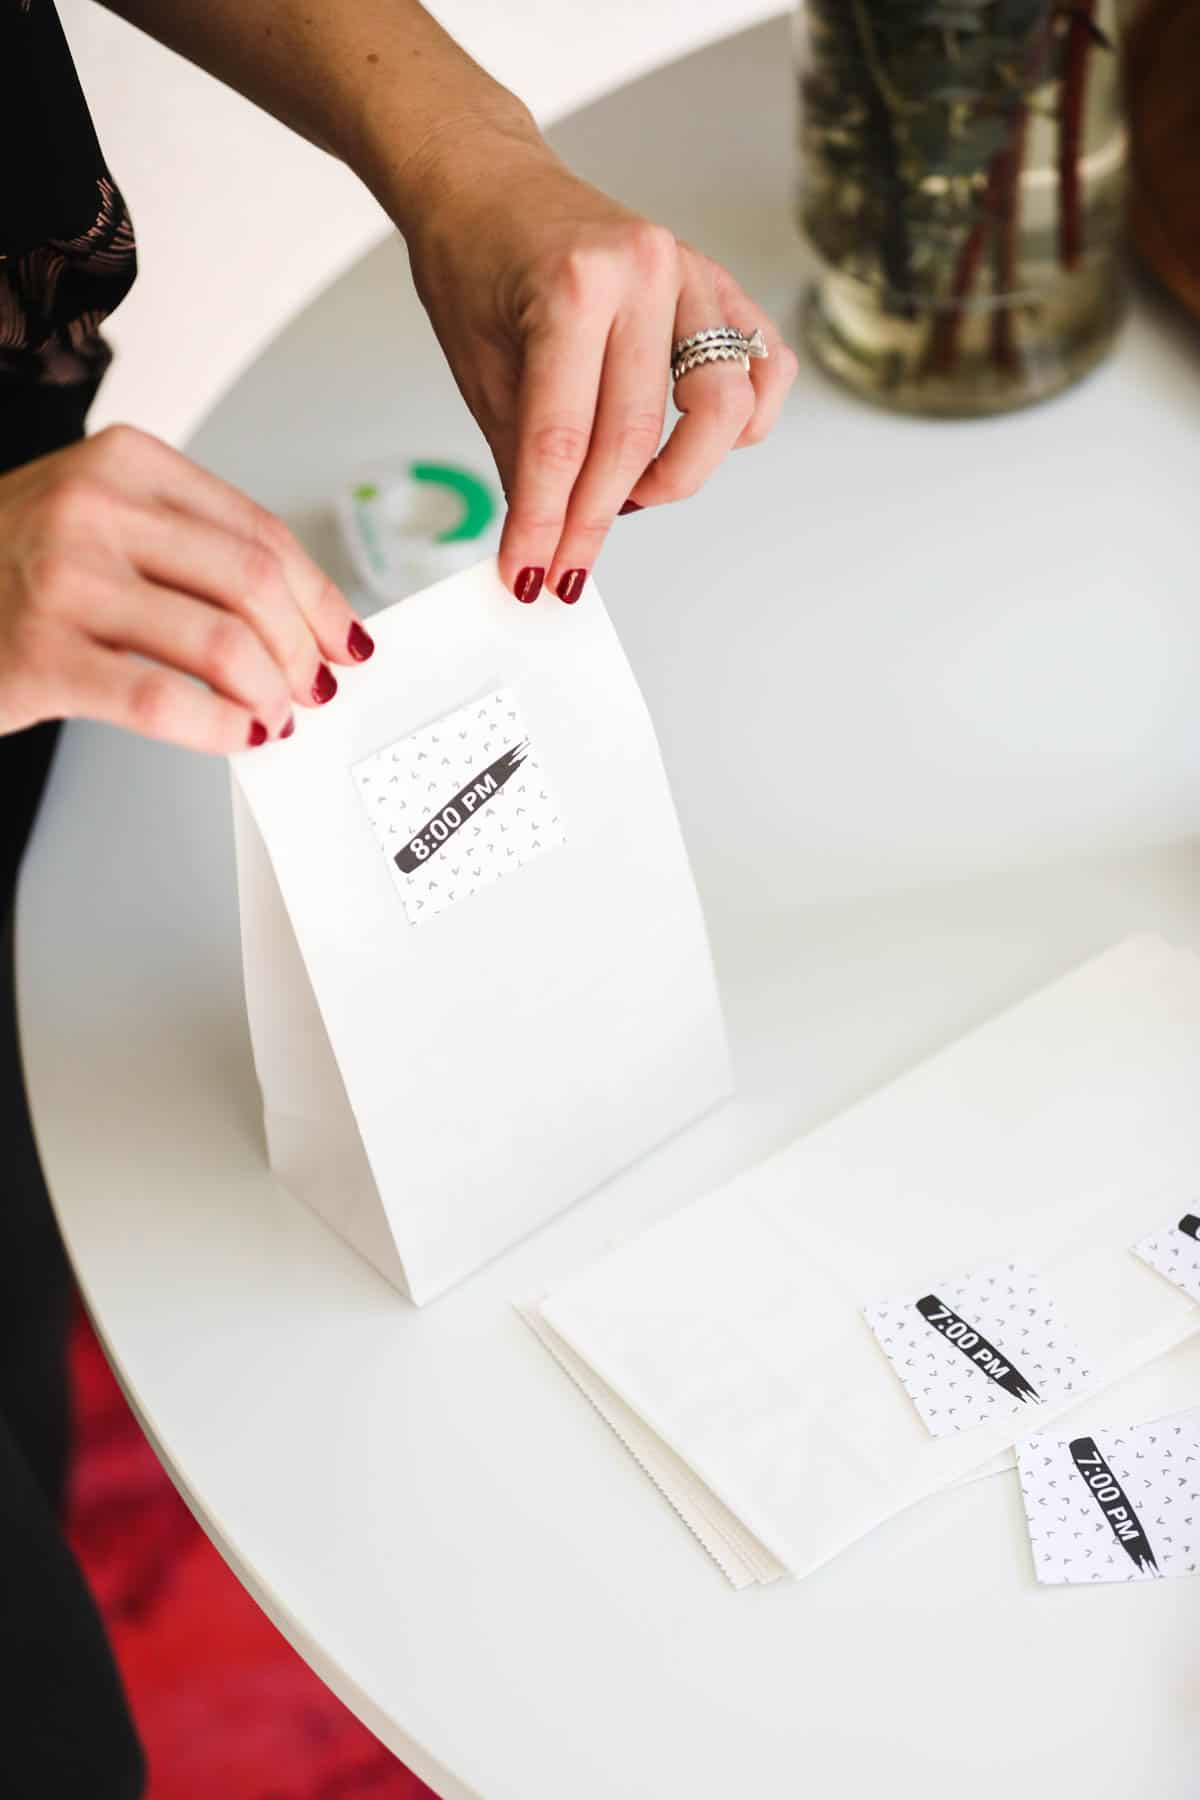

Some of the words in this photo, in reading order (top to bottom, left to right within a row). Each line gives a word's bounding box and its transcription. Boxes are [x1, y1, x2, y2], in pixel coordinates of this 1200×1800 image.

[410, 806, 461, 860] 8:00
[461, 773, 498, 812] PM
[927, 1304, 979, 1350] 7:00
[972, 1348, 1010, 1379] PM
[1076, 1451, 1121, 1502] 7:00
[1107, 1506, 1140, 1541] PM
